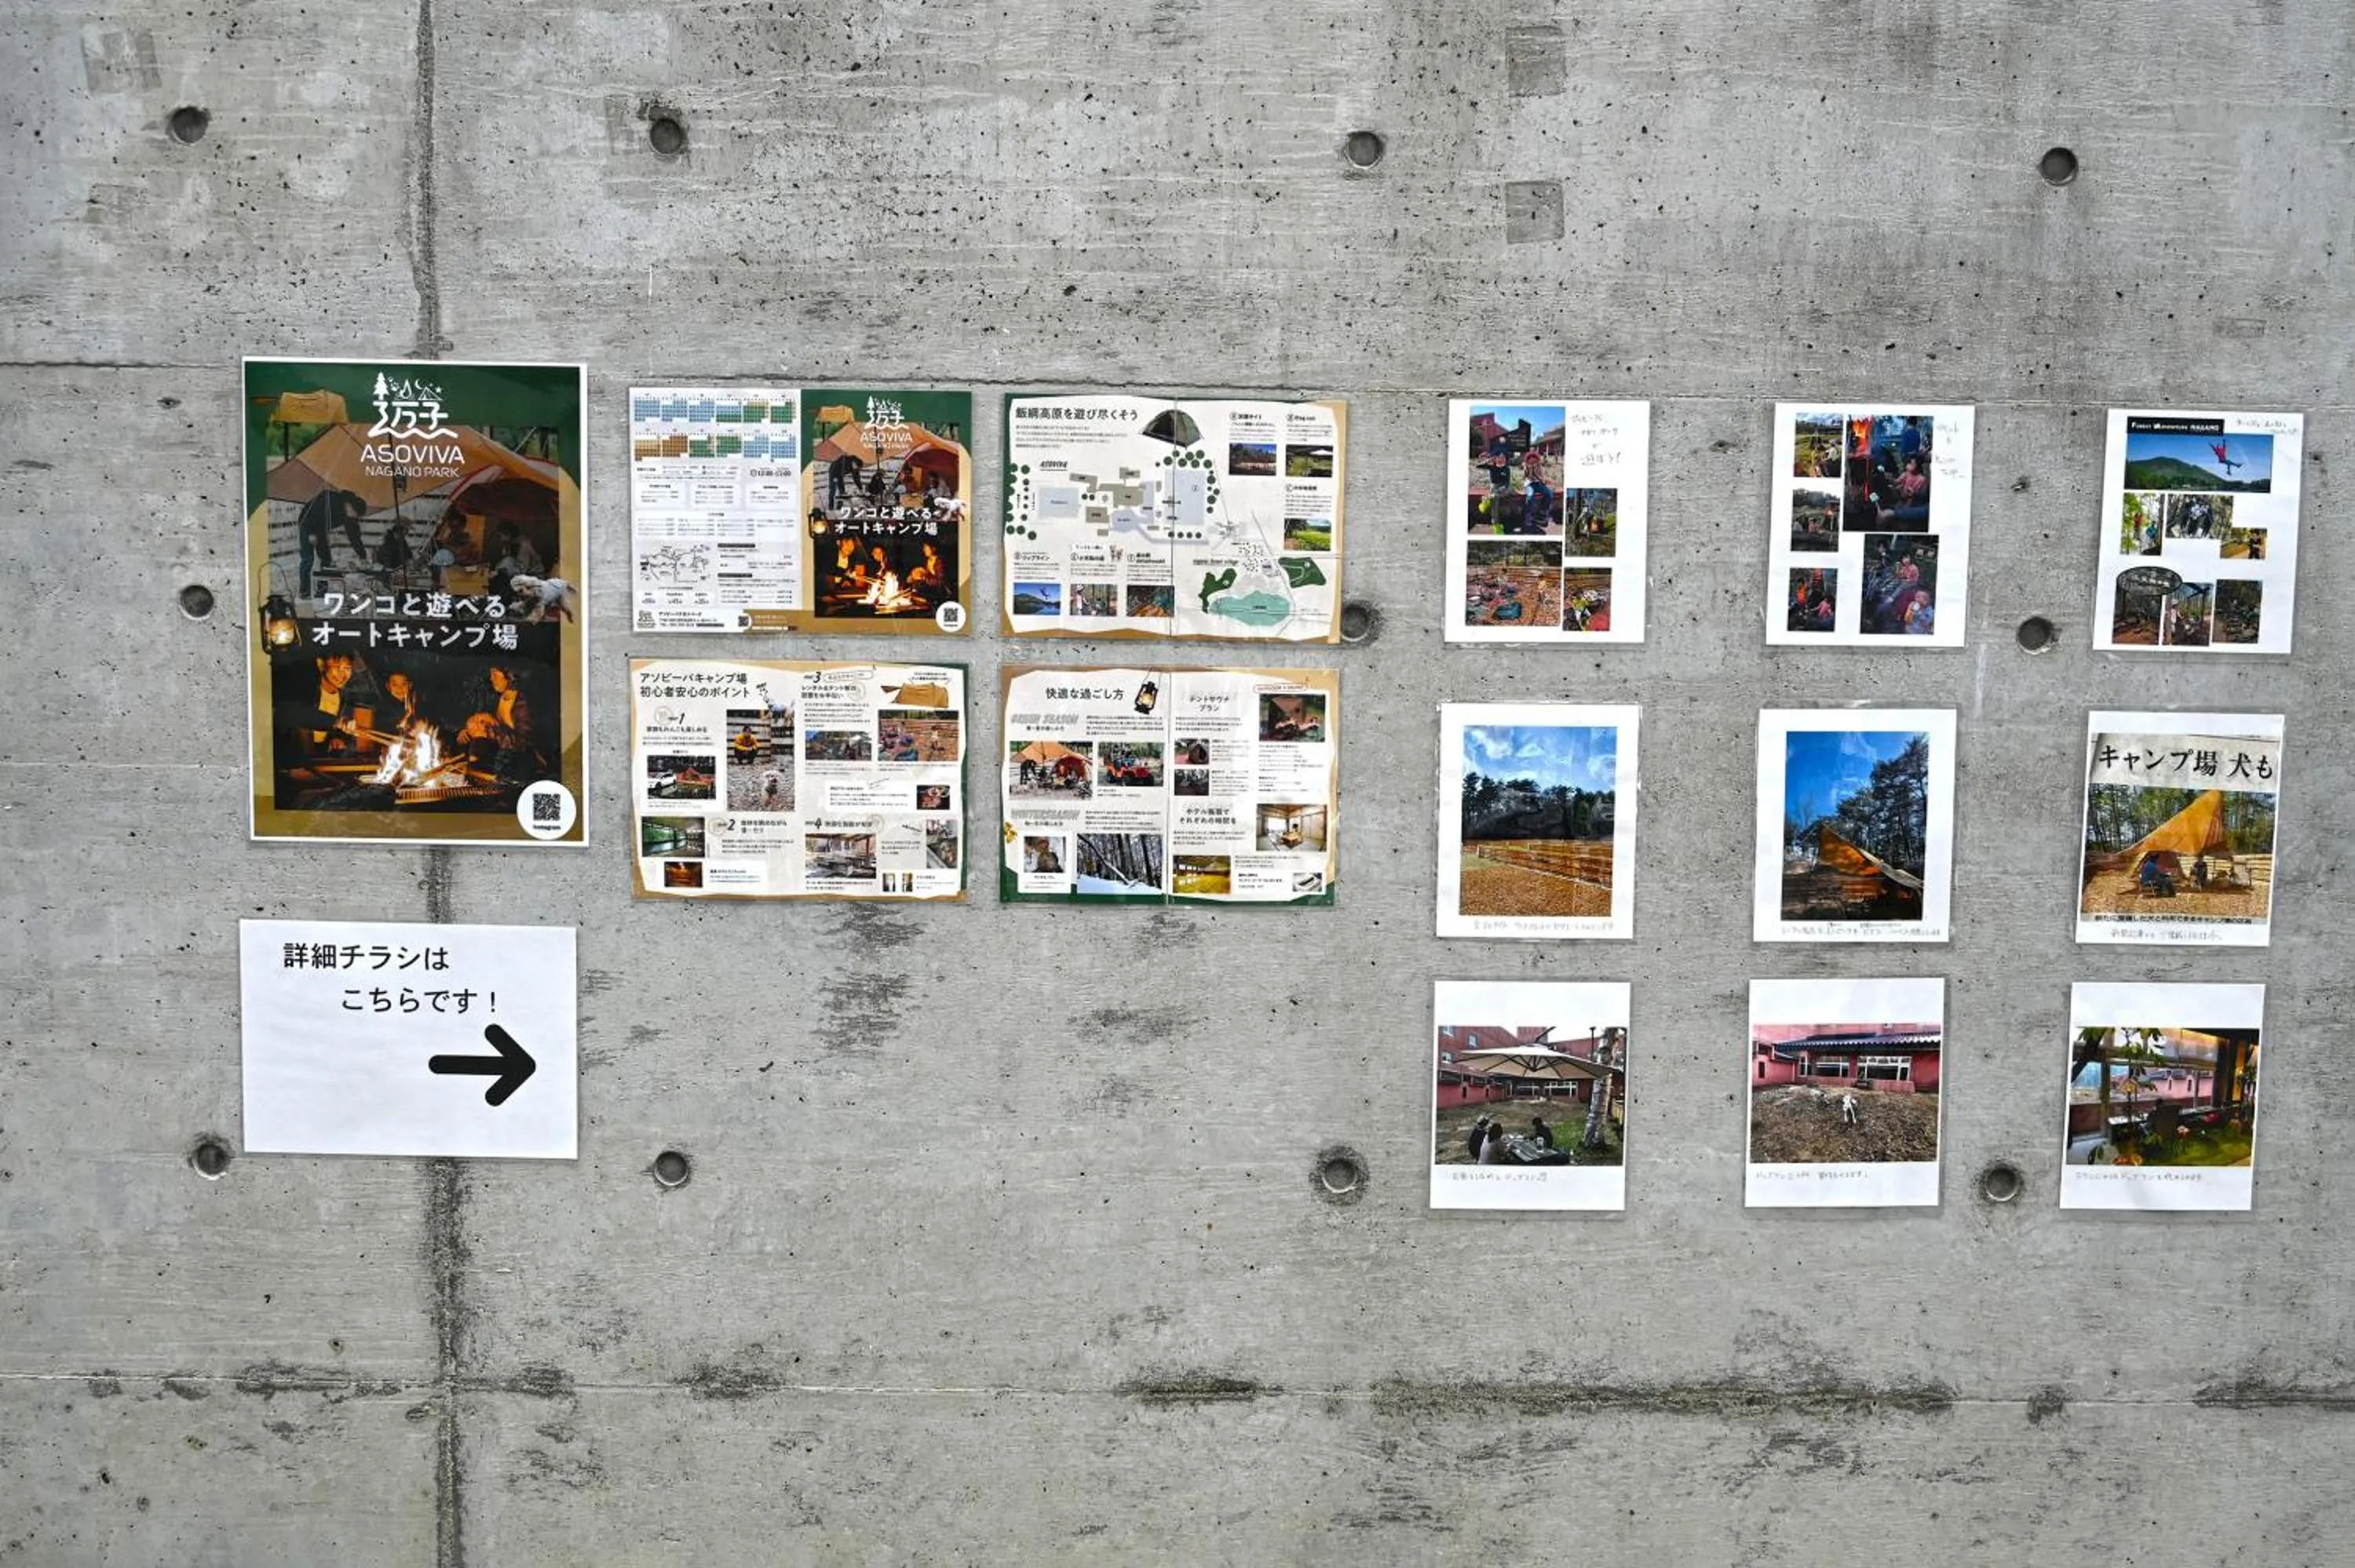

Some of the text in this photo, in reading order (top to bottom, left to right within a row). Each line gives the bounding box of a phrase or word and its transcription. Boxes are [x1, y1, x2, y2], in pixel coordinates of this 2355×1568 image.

[1015, 407, 1138, 421] 飯綱高原を遊び尽くそう
[860, 432, 913, 443] ASOVIVA
[360, 444, 465, 464] ASOVIVA
[365, 466, 460, 478] NAGANO PARK
[841, 507, 933, 520] ワンコと遊べる
[834, 522, 938, 535] オートキャンプ場
[323, 593, 507, 618] ワンコと遊べる
[312, 622, 519, 650] オートキャンプ場
[640, 673, 748, 684] アソビーバキャンプ場
[812, 671, 822, 684] 3
[640, 686, 750, 698] 初心者安心のポイント
[1045, 687, 1125, 701] 快適な過ごし方
[2098, 746, 2273, 779] キャンプ場 犬も
[727, 819, 736, 831] 2
[814, 818, 822, 830] 4
[283, 943, 451, 971] 詳細チラシは
